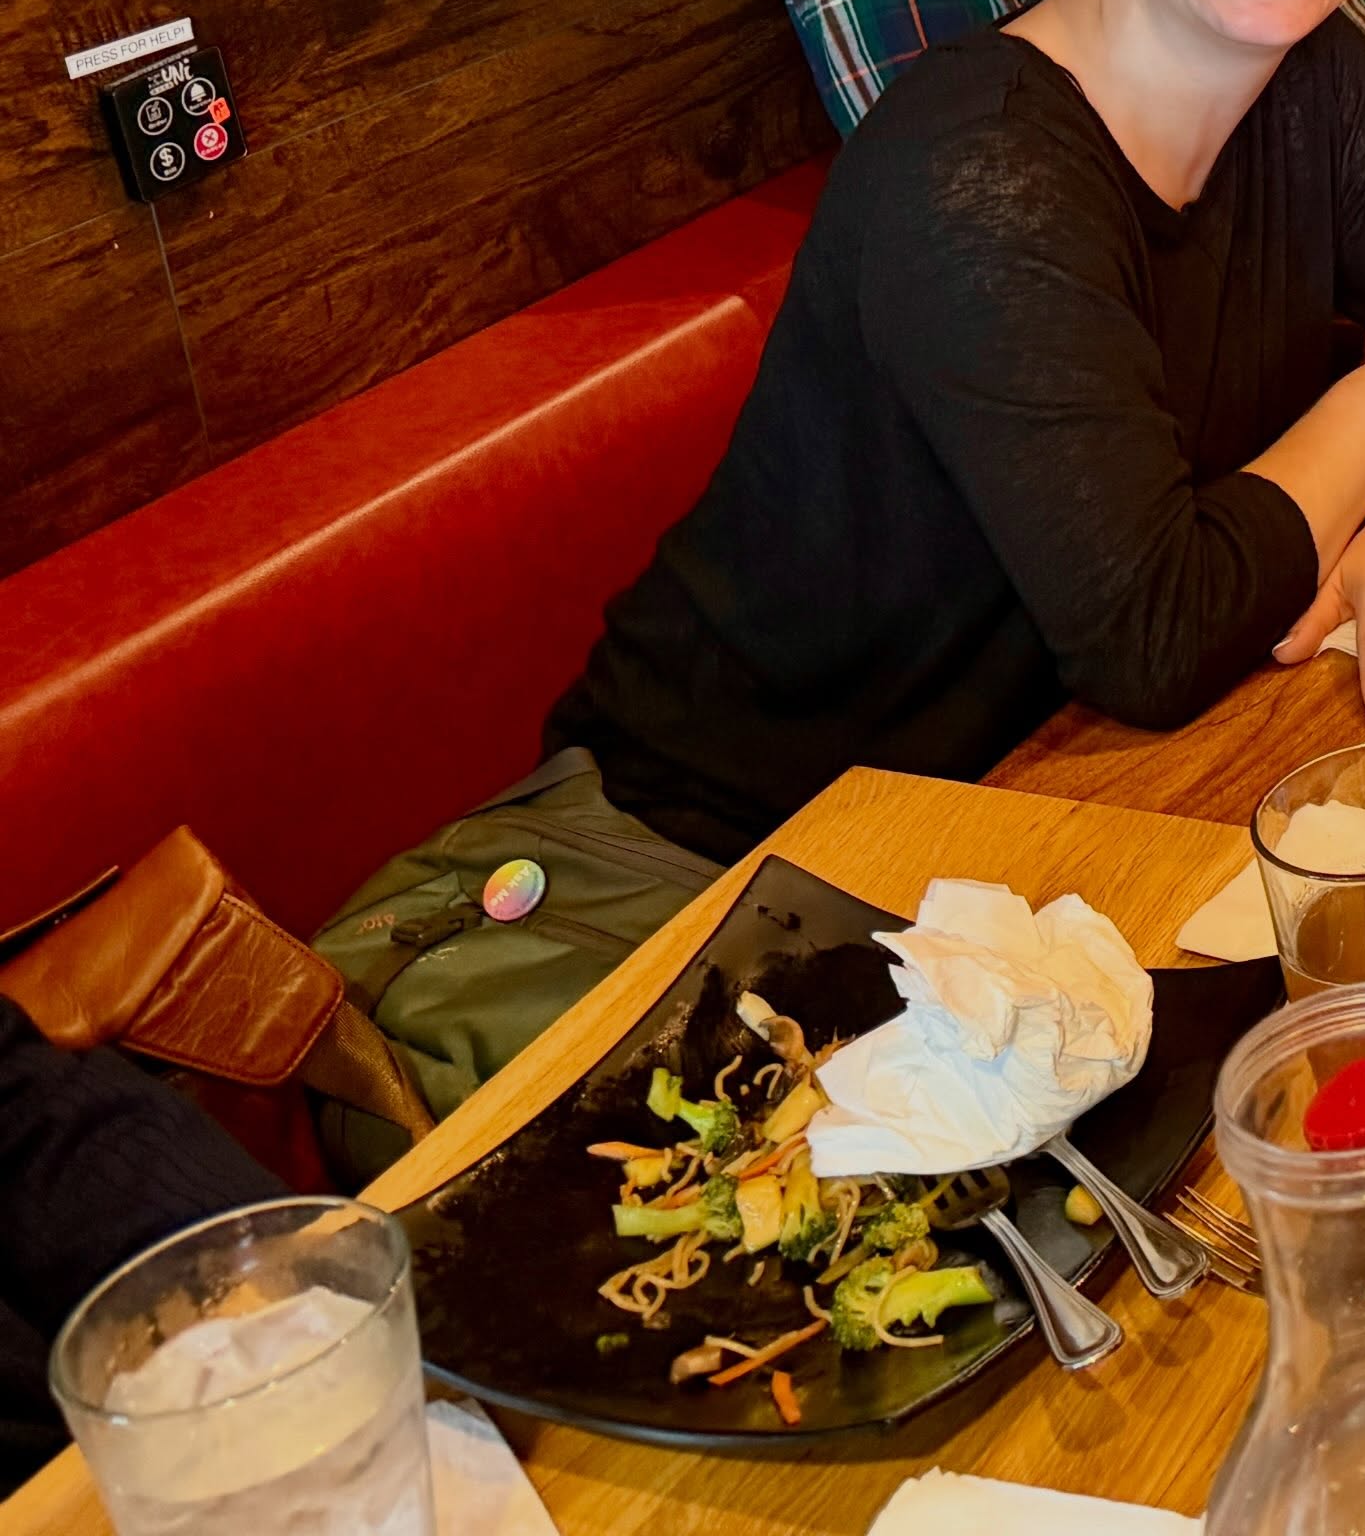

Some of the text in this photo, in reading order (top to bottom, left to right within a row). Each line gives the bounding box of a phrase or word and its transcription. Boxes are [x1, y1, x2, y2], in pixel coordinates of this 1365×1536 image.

[75, 25, 186, 73] PRESS FOR HELP!
